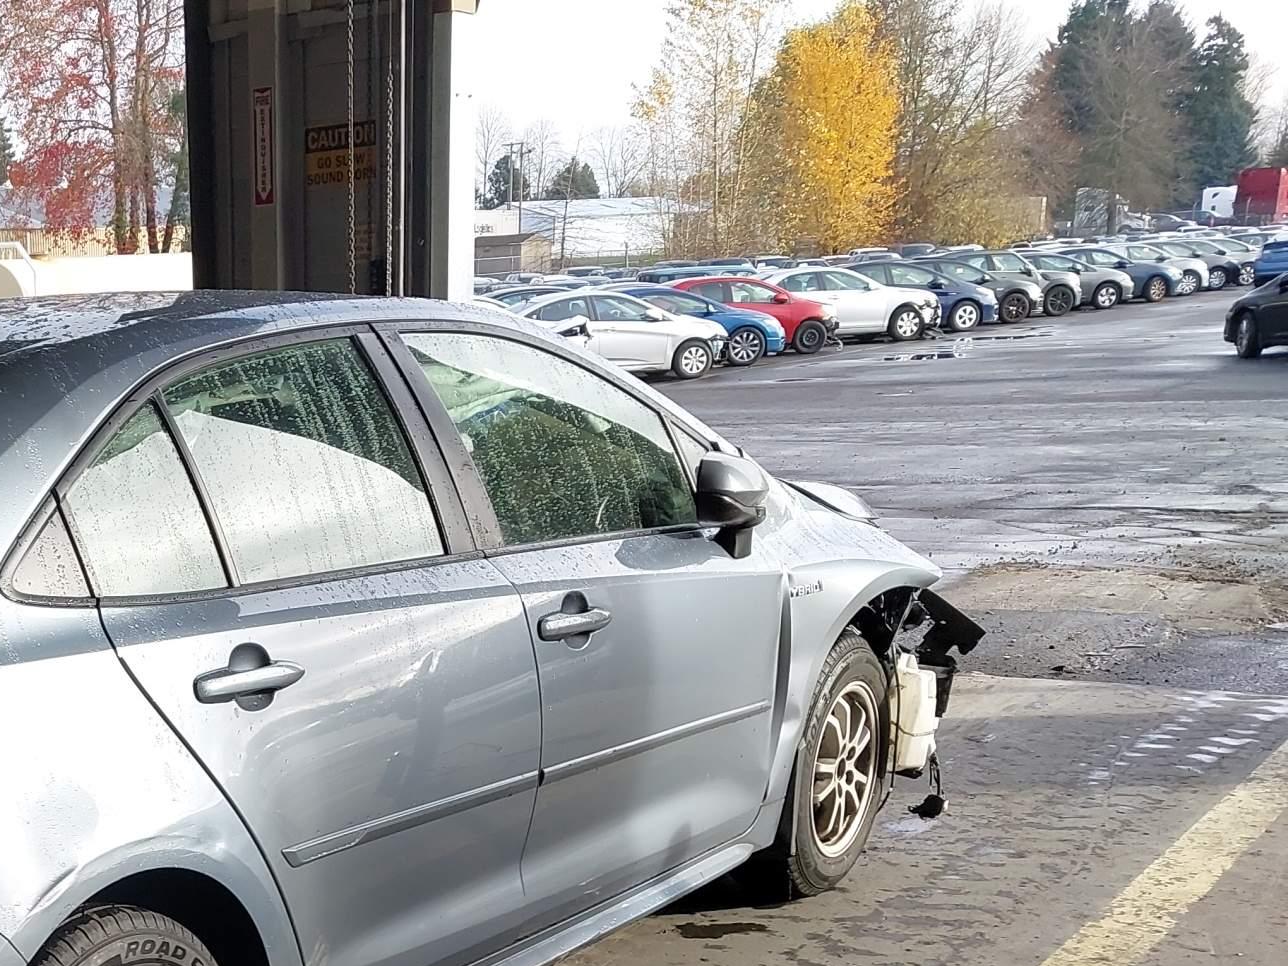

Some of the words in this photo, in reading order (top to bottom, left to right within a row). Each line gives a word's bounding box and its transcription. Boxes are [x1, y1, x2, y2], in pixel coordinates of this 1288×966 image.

[307, 123, 375, 150] CAUTON
[316, 157, 332, 169] GO
[307, 170, 344, 186] SOUND
[124, 939, 187, 961] ROAD
